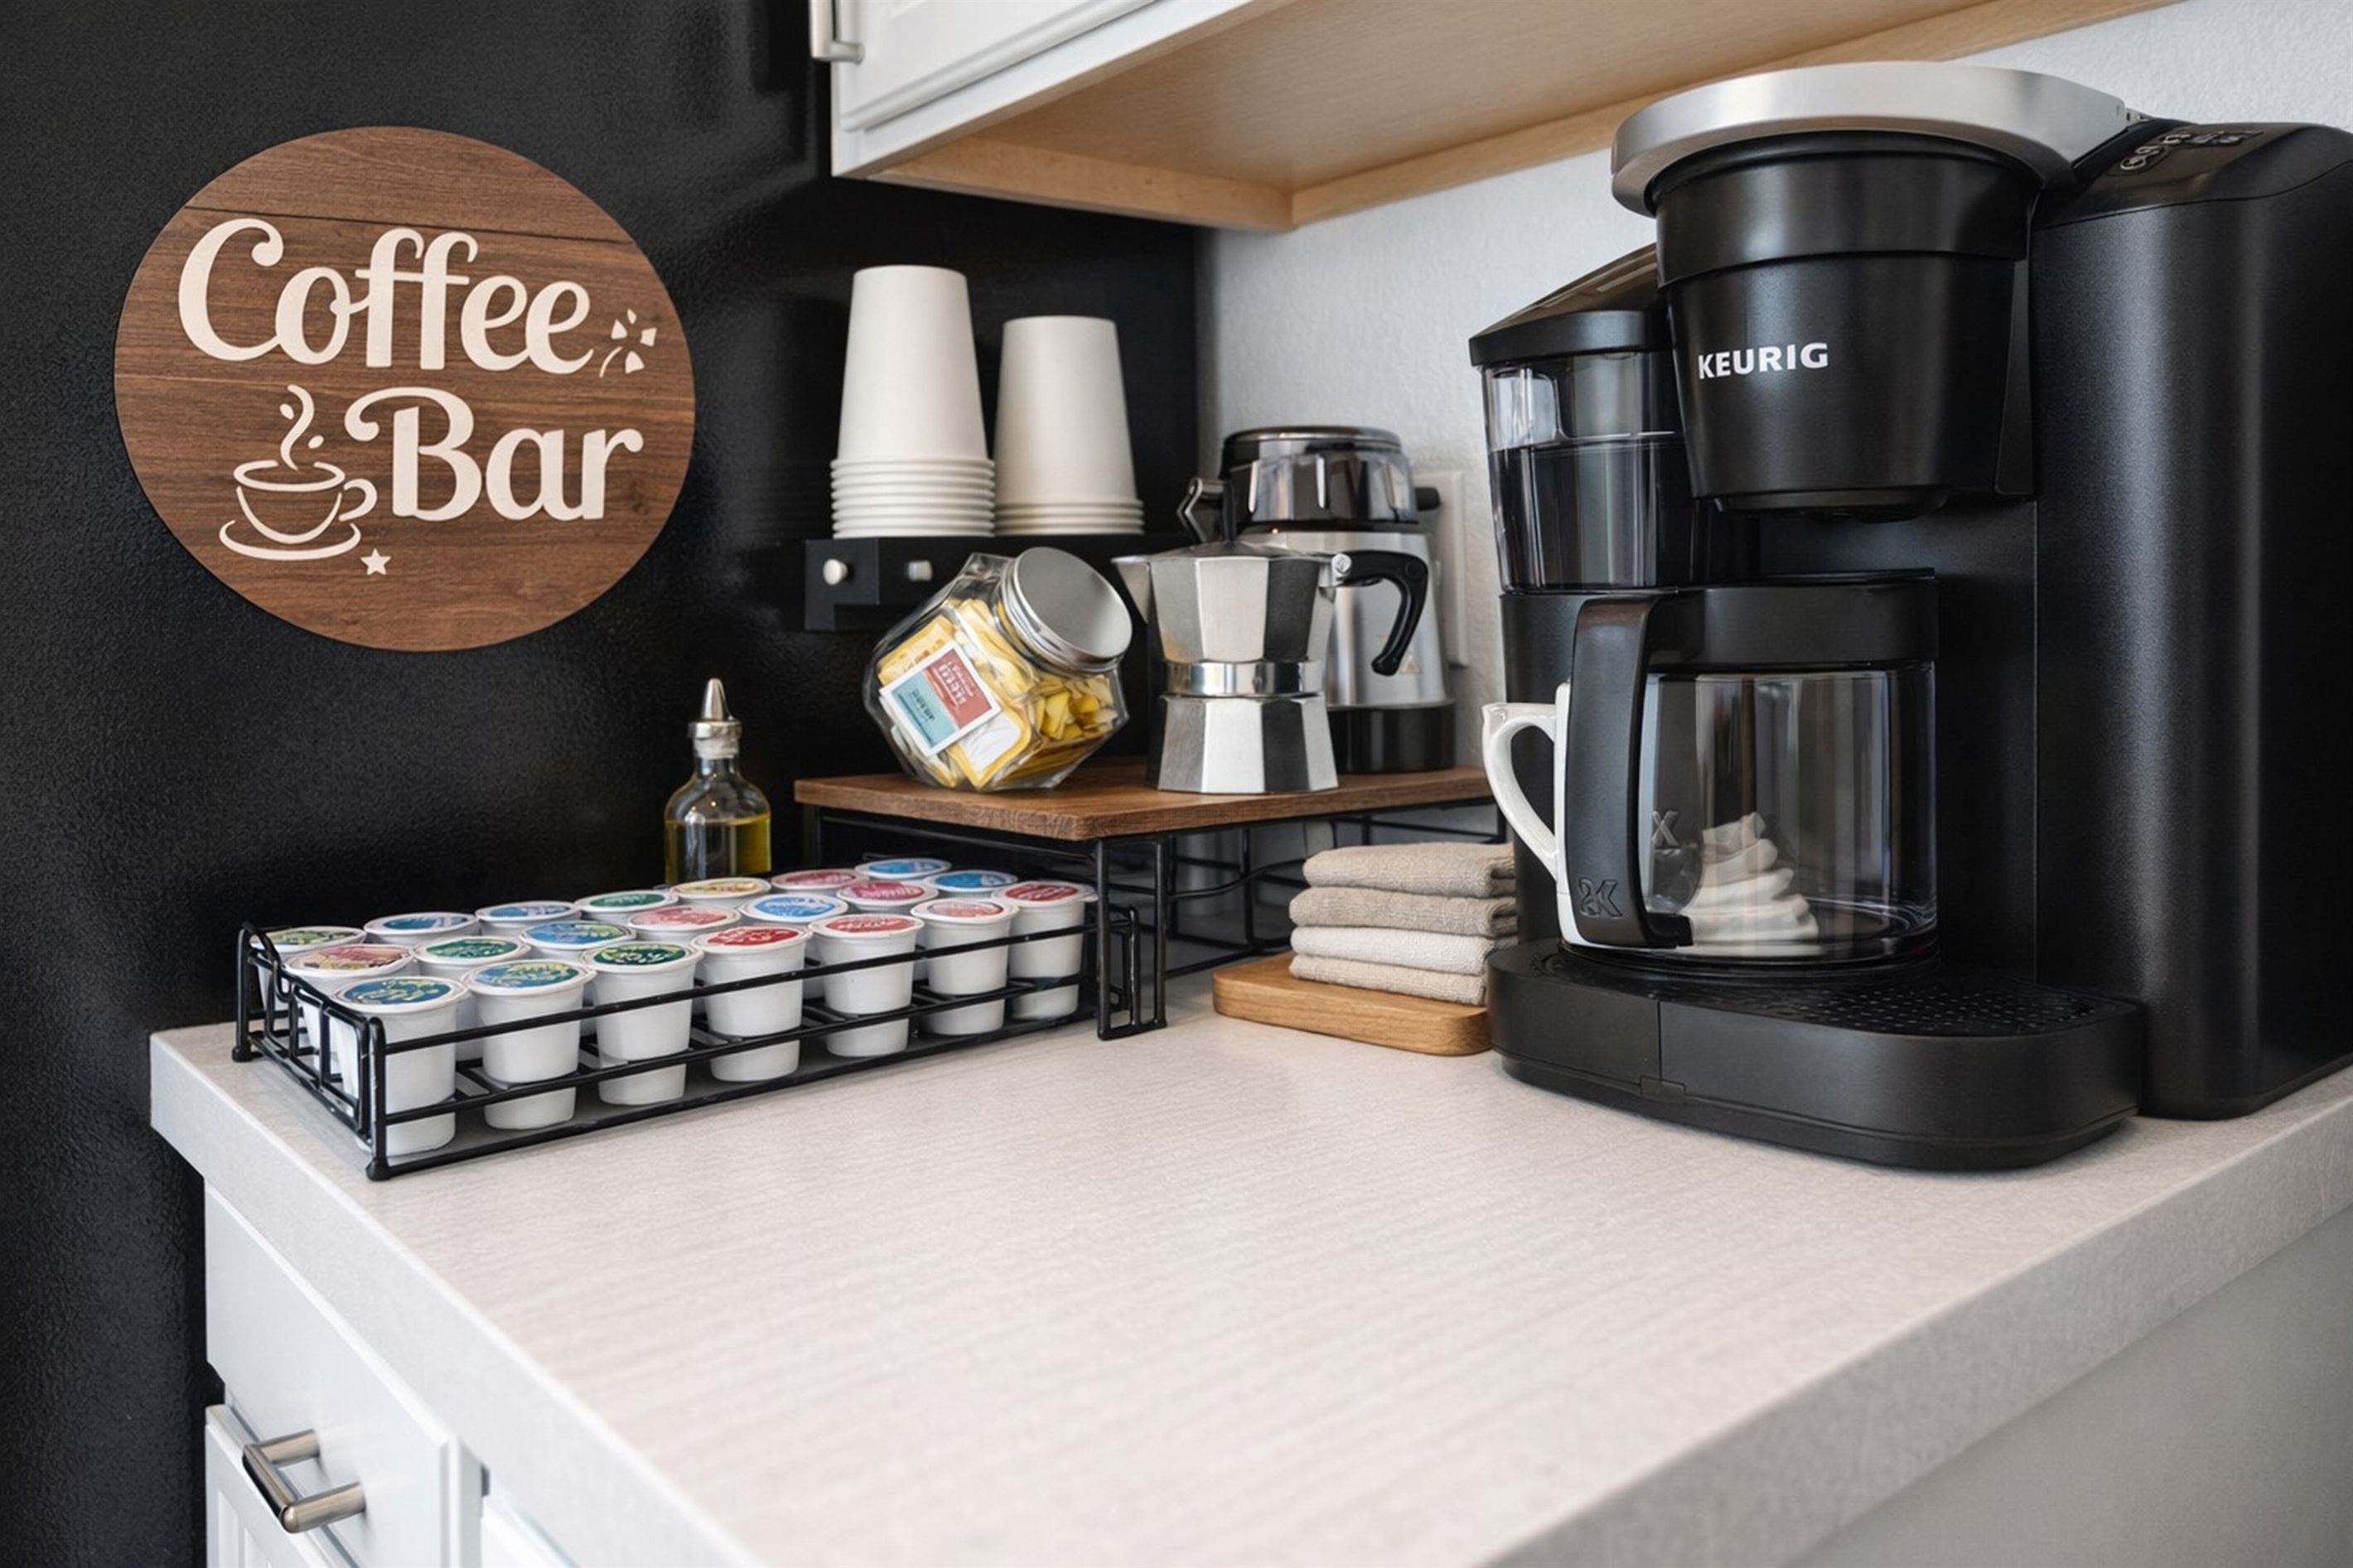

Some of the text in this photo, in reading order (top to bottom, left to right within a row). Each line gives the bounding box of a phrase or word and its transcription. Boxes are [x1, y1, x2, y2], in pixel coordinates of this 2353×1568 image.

[177, 218, 594, 374] Coffee
[1698, 342, 1829, 380] KEURIG
[344, 387, 644, 521] Bar
